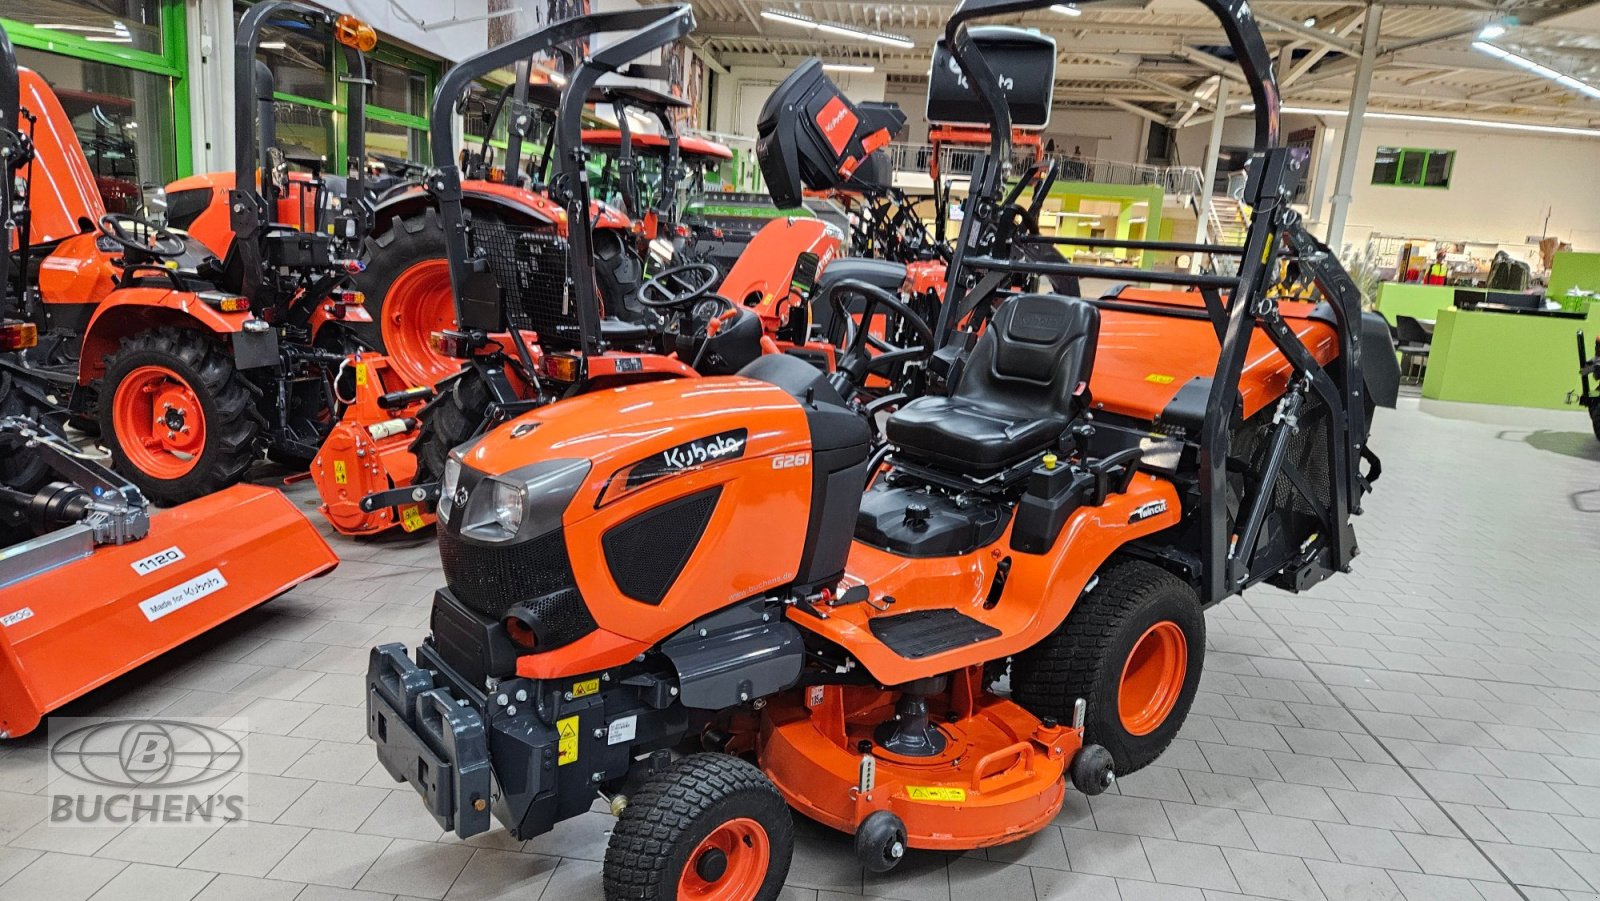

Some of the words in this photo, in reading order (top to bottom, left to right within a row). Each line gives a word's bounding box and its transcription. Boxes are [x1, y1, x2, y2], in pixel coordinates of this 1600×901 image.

[664, 436, 738, 468] Kubota
[772, 452, 810, 470] G261
[138, 550, 179, 570] 1120
[149, 600, 173, 614] Made
[171, 594, 184, 604] for
[182, 577, 220, 597] Kubota
[727, 572, 793, 601] www.buchens.de
[3, 609, 32, 625] FROG
